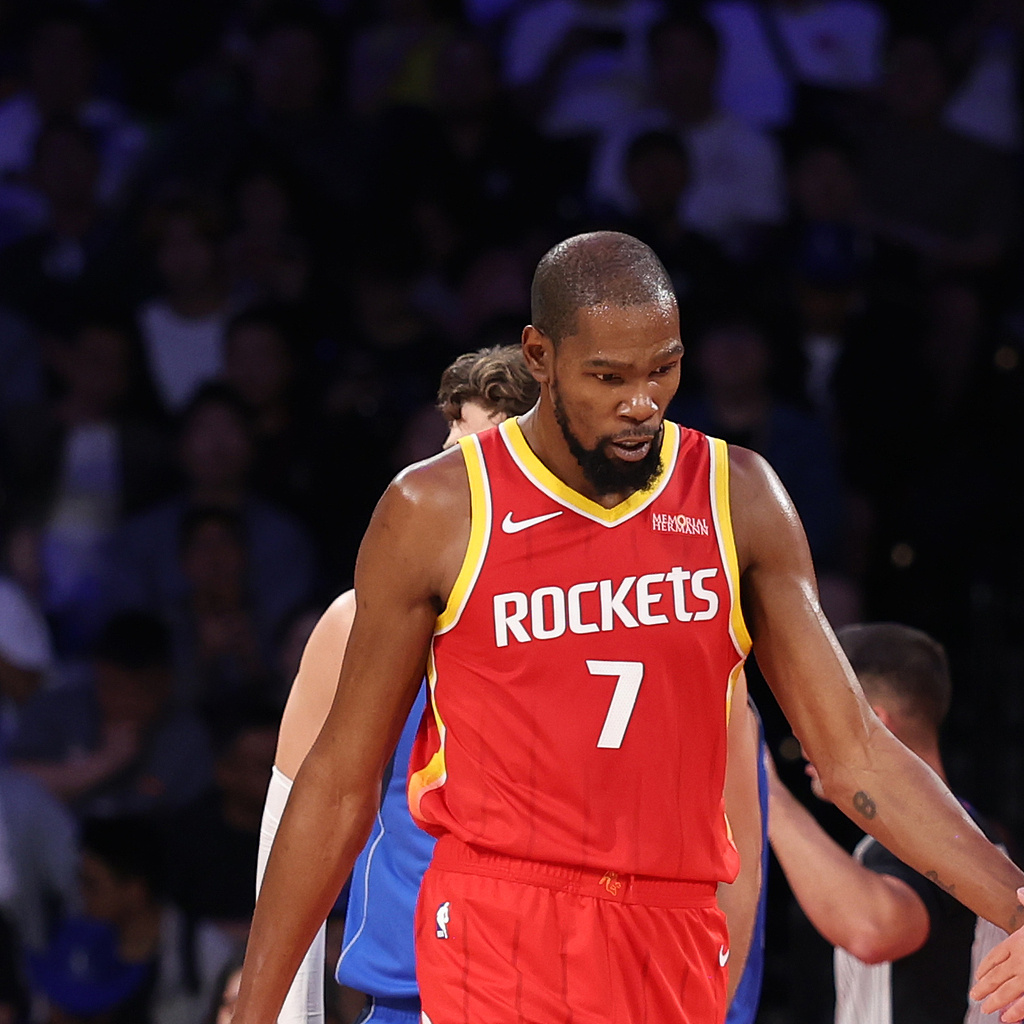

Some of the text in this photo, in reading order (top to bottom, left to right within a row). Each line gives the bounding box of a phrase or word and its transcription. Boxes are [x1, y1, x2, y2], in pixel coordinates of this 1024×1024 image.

[652, 512, 706, 527] MEMORIAL
[652, 520, 709, 536] HERMANN
[493, 566, 719, 648] ROCKETS
[585, 659, 645, 749] 7
